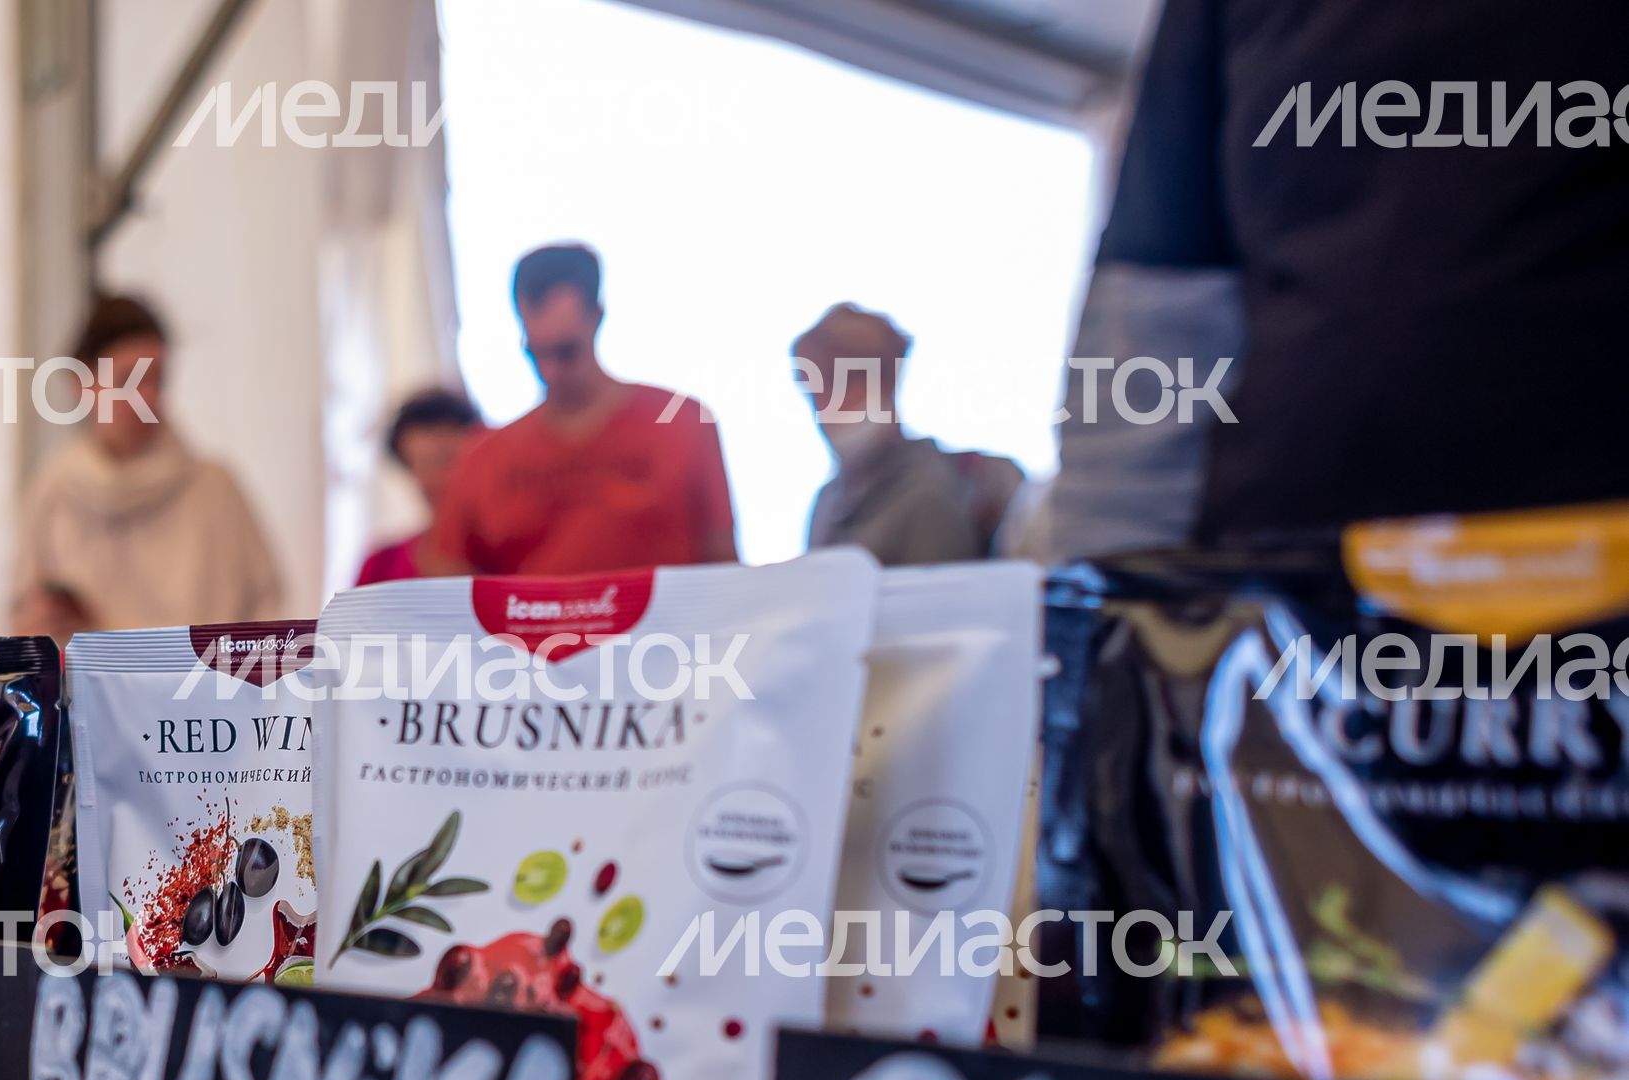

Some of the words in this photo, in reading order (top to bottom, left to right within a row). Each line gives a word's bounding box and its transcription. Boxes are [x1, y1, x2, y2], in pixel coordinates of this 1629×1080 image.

[220, 628, 298, 653] icancook
[157, 718, 237, 753] RED
[395, 701, 687, 751] BRUSNIKA
[139, 766, 312, 784] ГАСТРОНОМИЧЕСКИЙ
[359, 763, 631, 792] ГАСТРОНОМИЧЕСКИЙ
